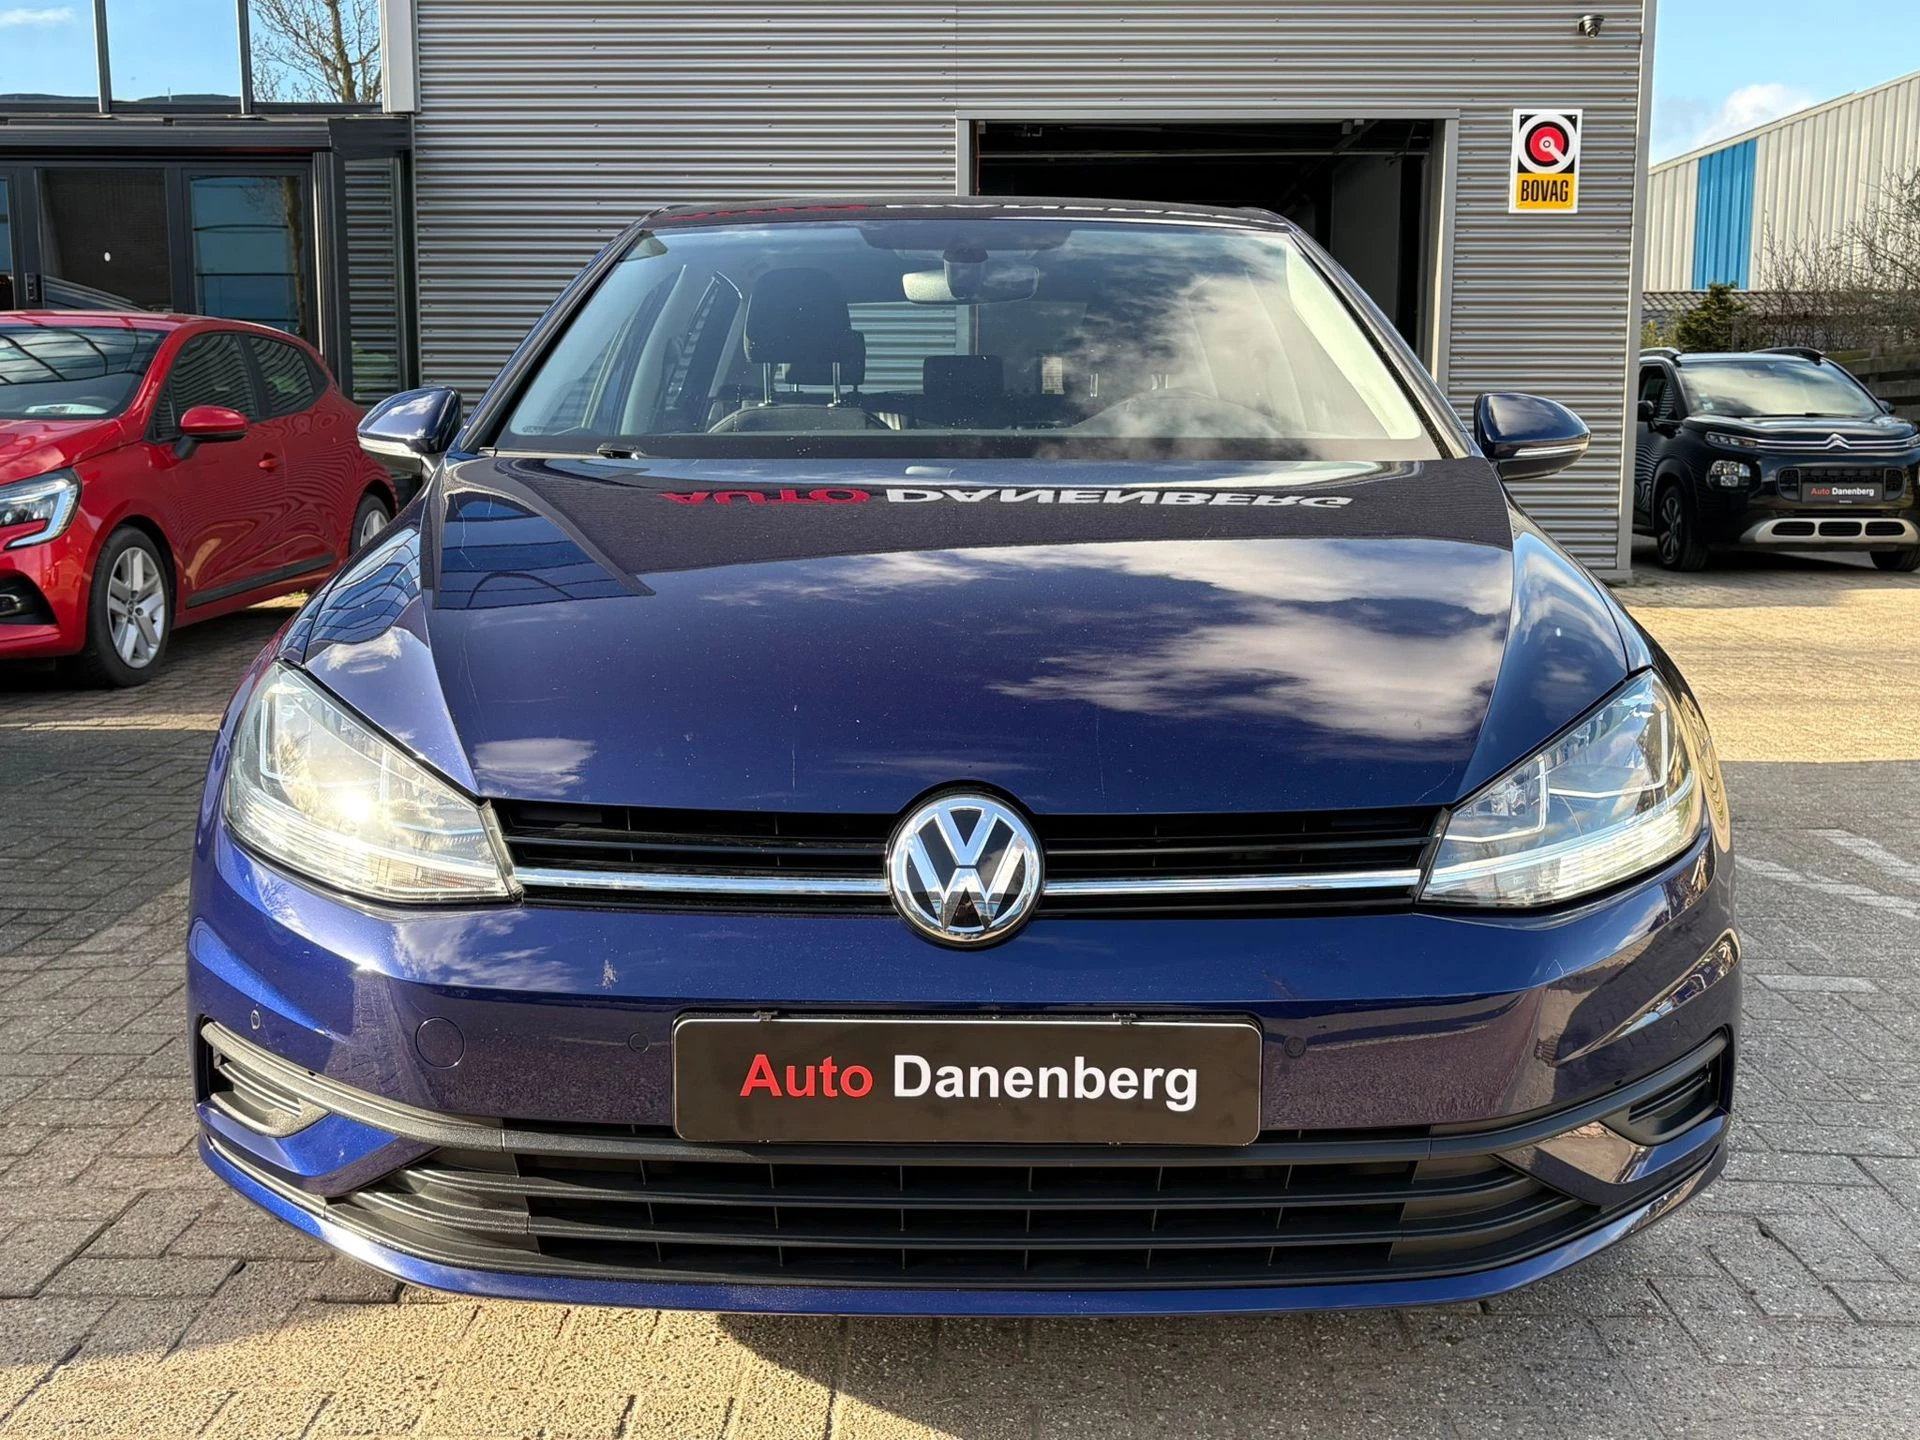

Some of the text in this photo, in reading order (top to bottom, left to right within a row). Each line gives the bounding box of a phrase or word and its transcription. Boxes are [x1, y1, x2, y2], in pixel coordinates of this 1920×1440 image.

[1520, 179, 1569, 202] BOVAG
[1811, 487, 1875, 497] Auto Danenberg
[739, 1053, 1198, 1112] Auto Danenberg
